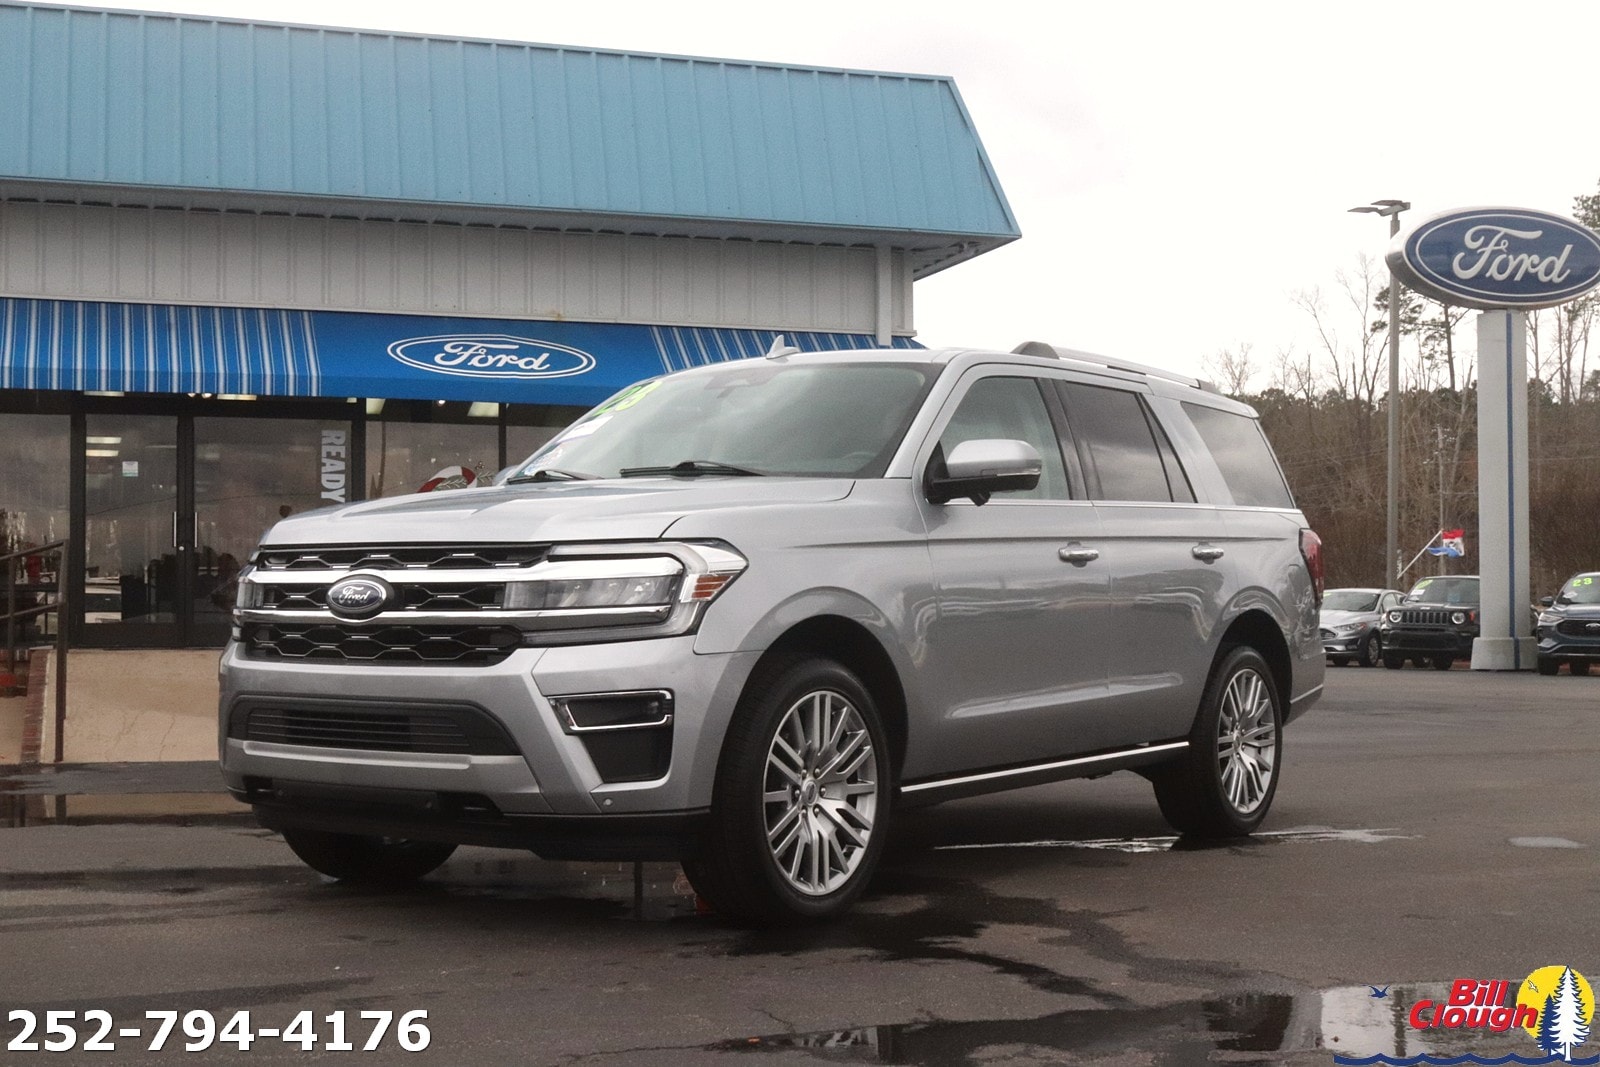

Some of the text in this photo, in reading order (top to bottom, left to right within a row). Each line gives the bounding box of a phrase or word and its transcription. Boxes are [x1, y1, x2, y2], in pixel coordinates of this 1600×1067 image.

[1452, 224, 1573, 283] Ford
[434, 342, 551, 371] Ford
[321, 430, 346, 503] READY
[339, 586, 371, 604] Ford
